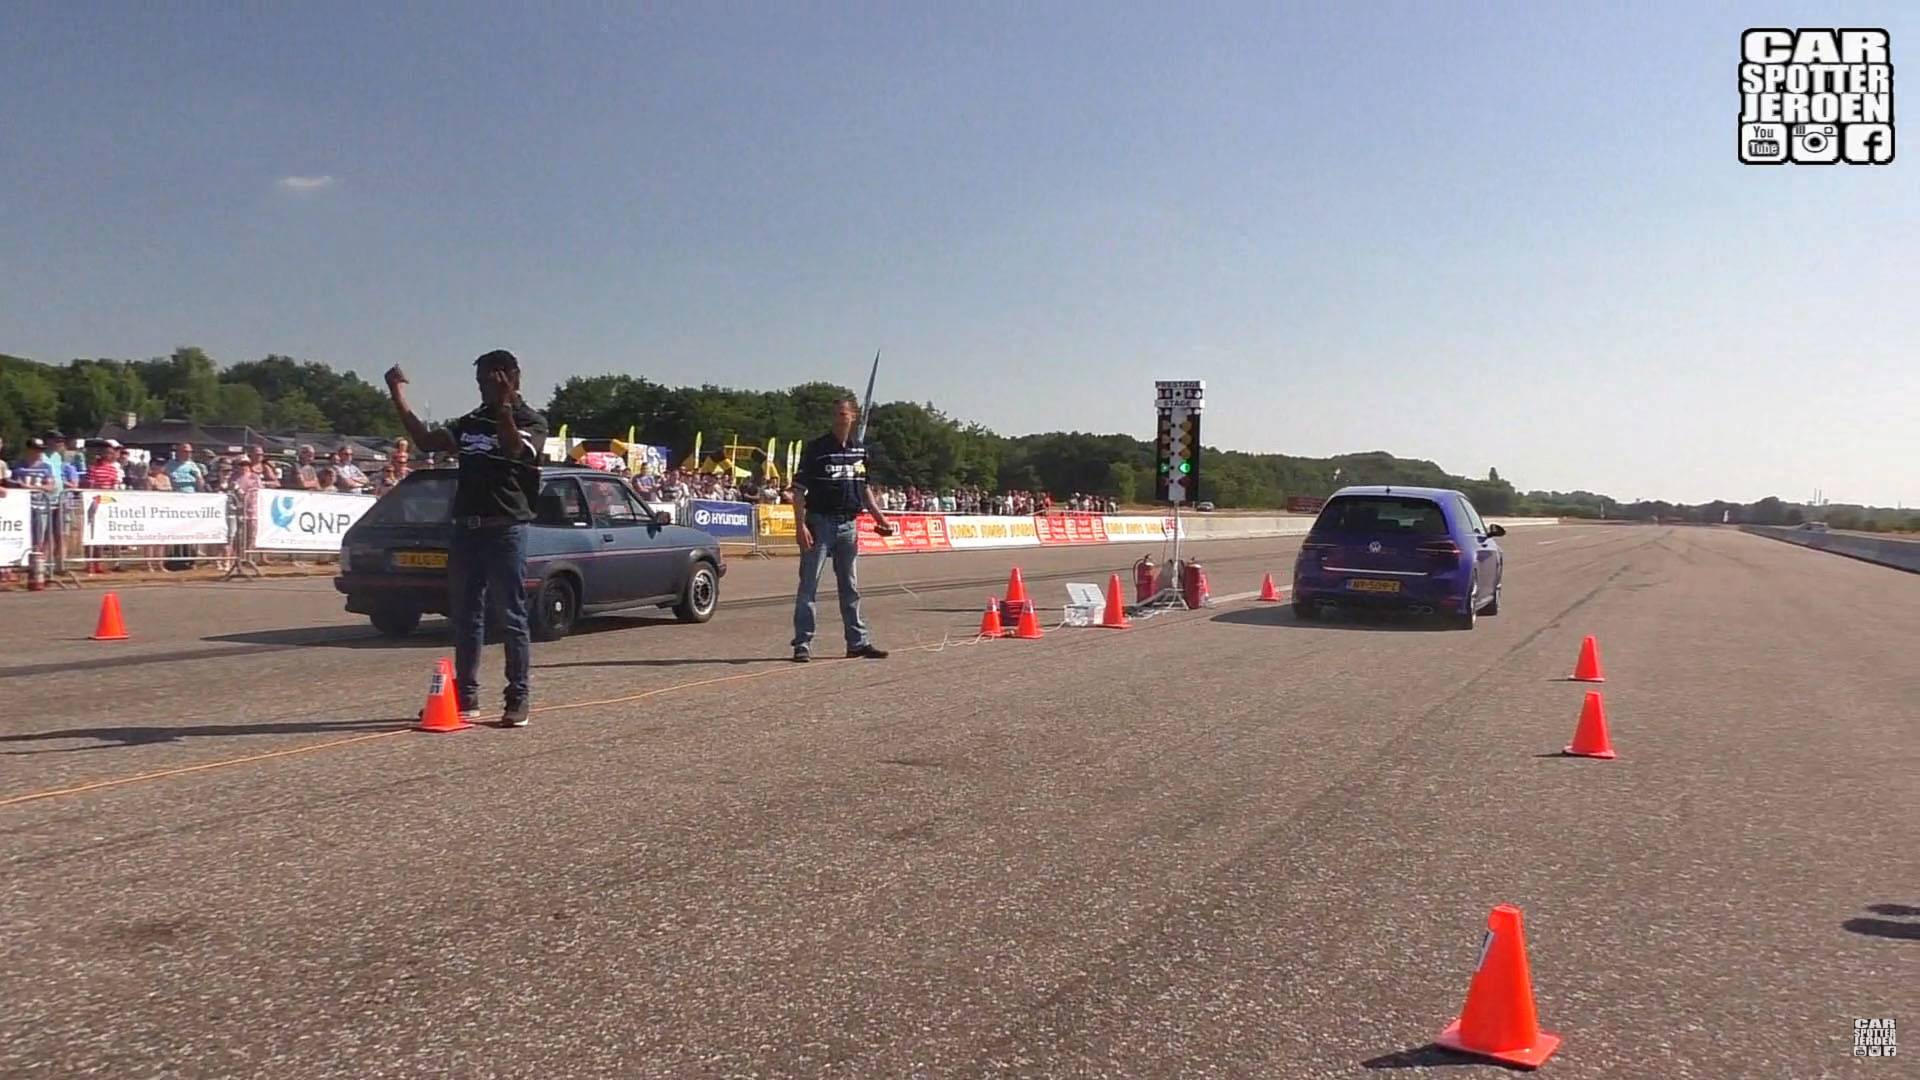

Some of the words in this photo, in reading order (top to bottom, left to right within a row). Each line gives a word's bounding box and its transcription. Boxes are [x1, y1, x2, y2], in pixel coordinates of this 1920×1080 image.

[108, 506, 146, 519] Hotel
[150, 506, 221, 519] Princeville
[108, 520, 145, 532] Breda
[711, 513, 748, 526] HYUNDAI
